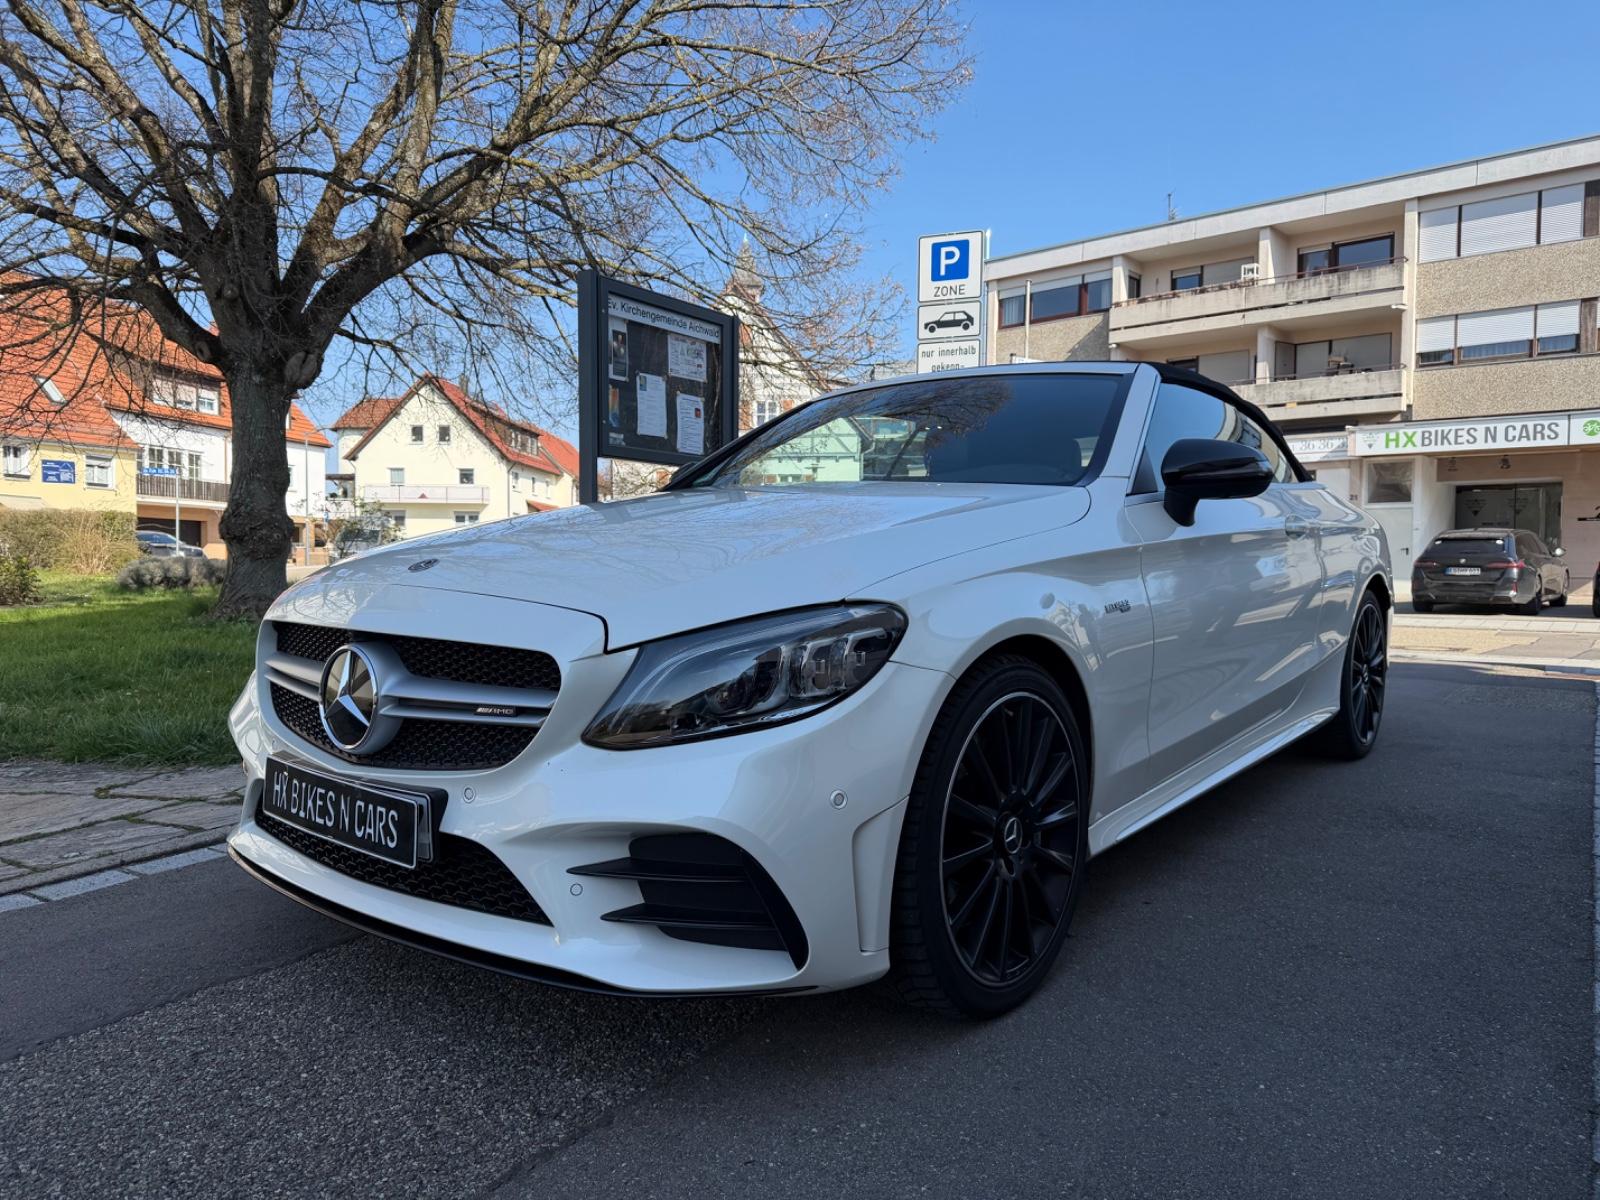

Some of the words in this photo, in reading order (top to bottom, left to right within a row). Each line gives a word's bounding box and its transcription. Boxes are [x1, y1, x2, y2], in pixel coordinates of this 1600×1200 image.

[940, 246, 960, 276] P
[933, 284, 966, 298] ZONE
[620, 301, 688, 330] Kirchengemeinde
[688, 314, 720, 338] Aichwald
[921, 350, 935, 359] nur
[938, 345, 977, 357] innerhalb
[1384, 431, 1418, 449] HX
[1421, 427, 1478, 447] BIKES
[1484, 426, 1498, 444] N
[1504, 422, 1560, 442] CARS
[272, 771, 289, 810] HX
[290, 779, 335, 827] BIKES
[340, 793, 350, 832] N
[354, 800, 398, 848] CARS
